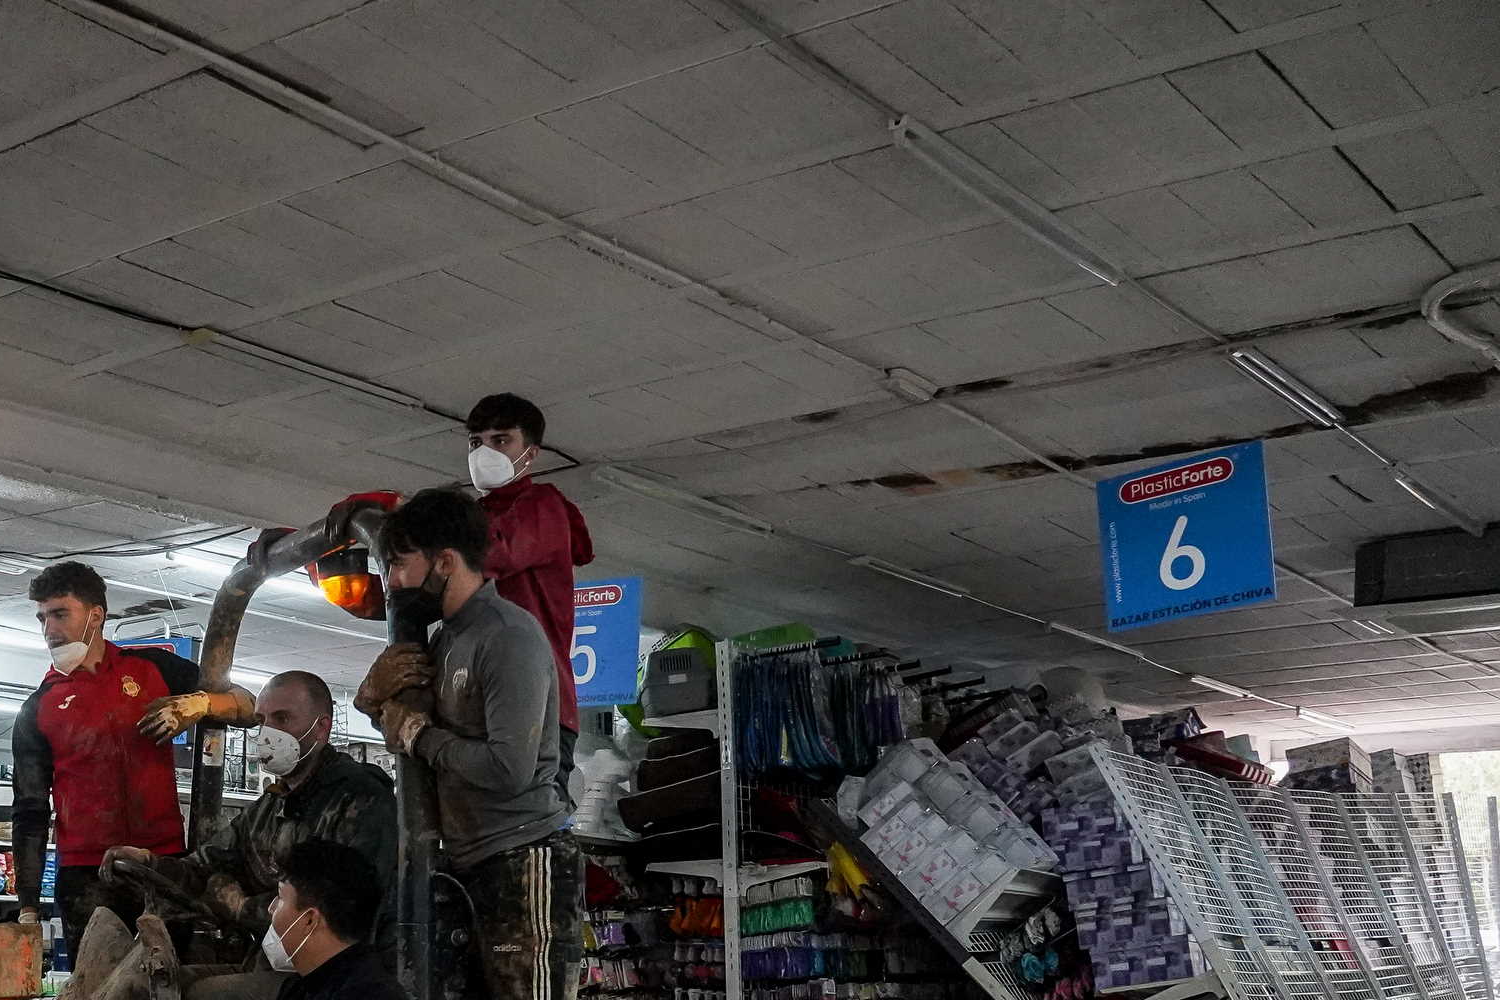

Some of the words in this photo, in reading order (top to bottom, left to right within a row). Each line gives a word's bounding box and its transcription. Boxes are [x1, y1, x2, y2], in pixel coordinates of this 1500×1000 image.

[1130, 465, 1224, 498] PlasticForte
[1183, 492, 1207, 504] Spain
[1159, 515, 1206, 590] 6
[1111, 611, 1151, 628] BAZAR
[1215, 595, 1230, 606] DE
[1232, 586, 1274, 602] CHIVA
[570, 625, 597, 685] 5
